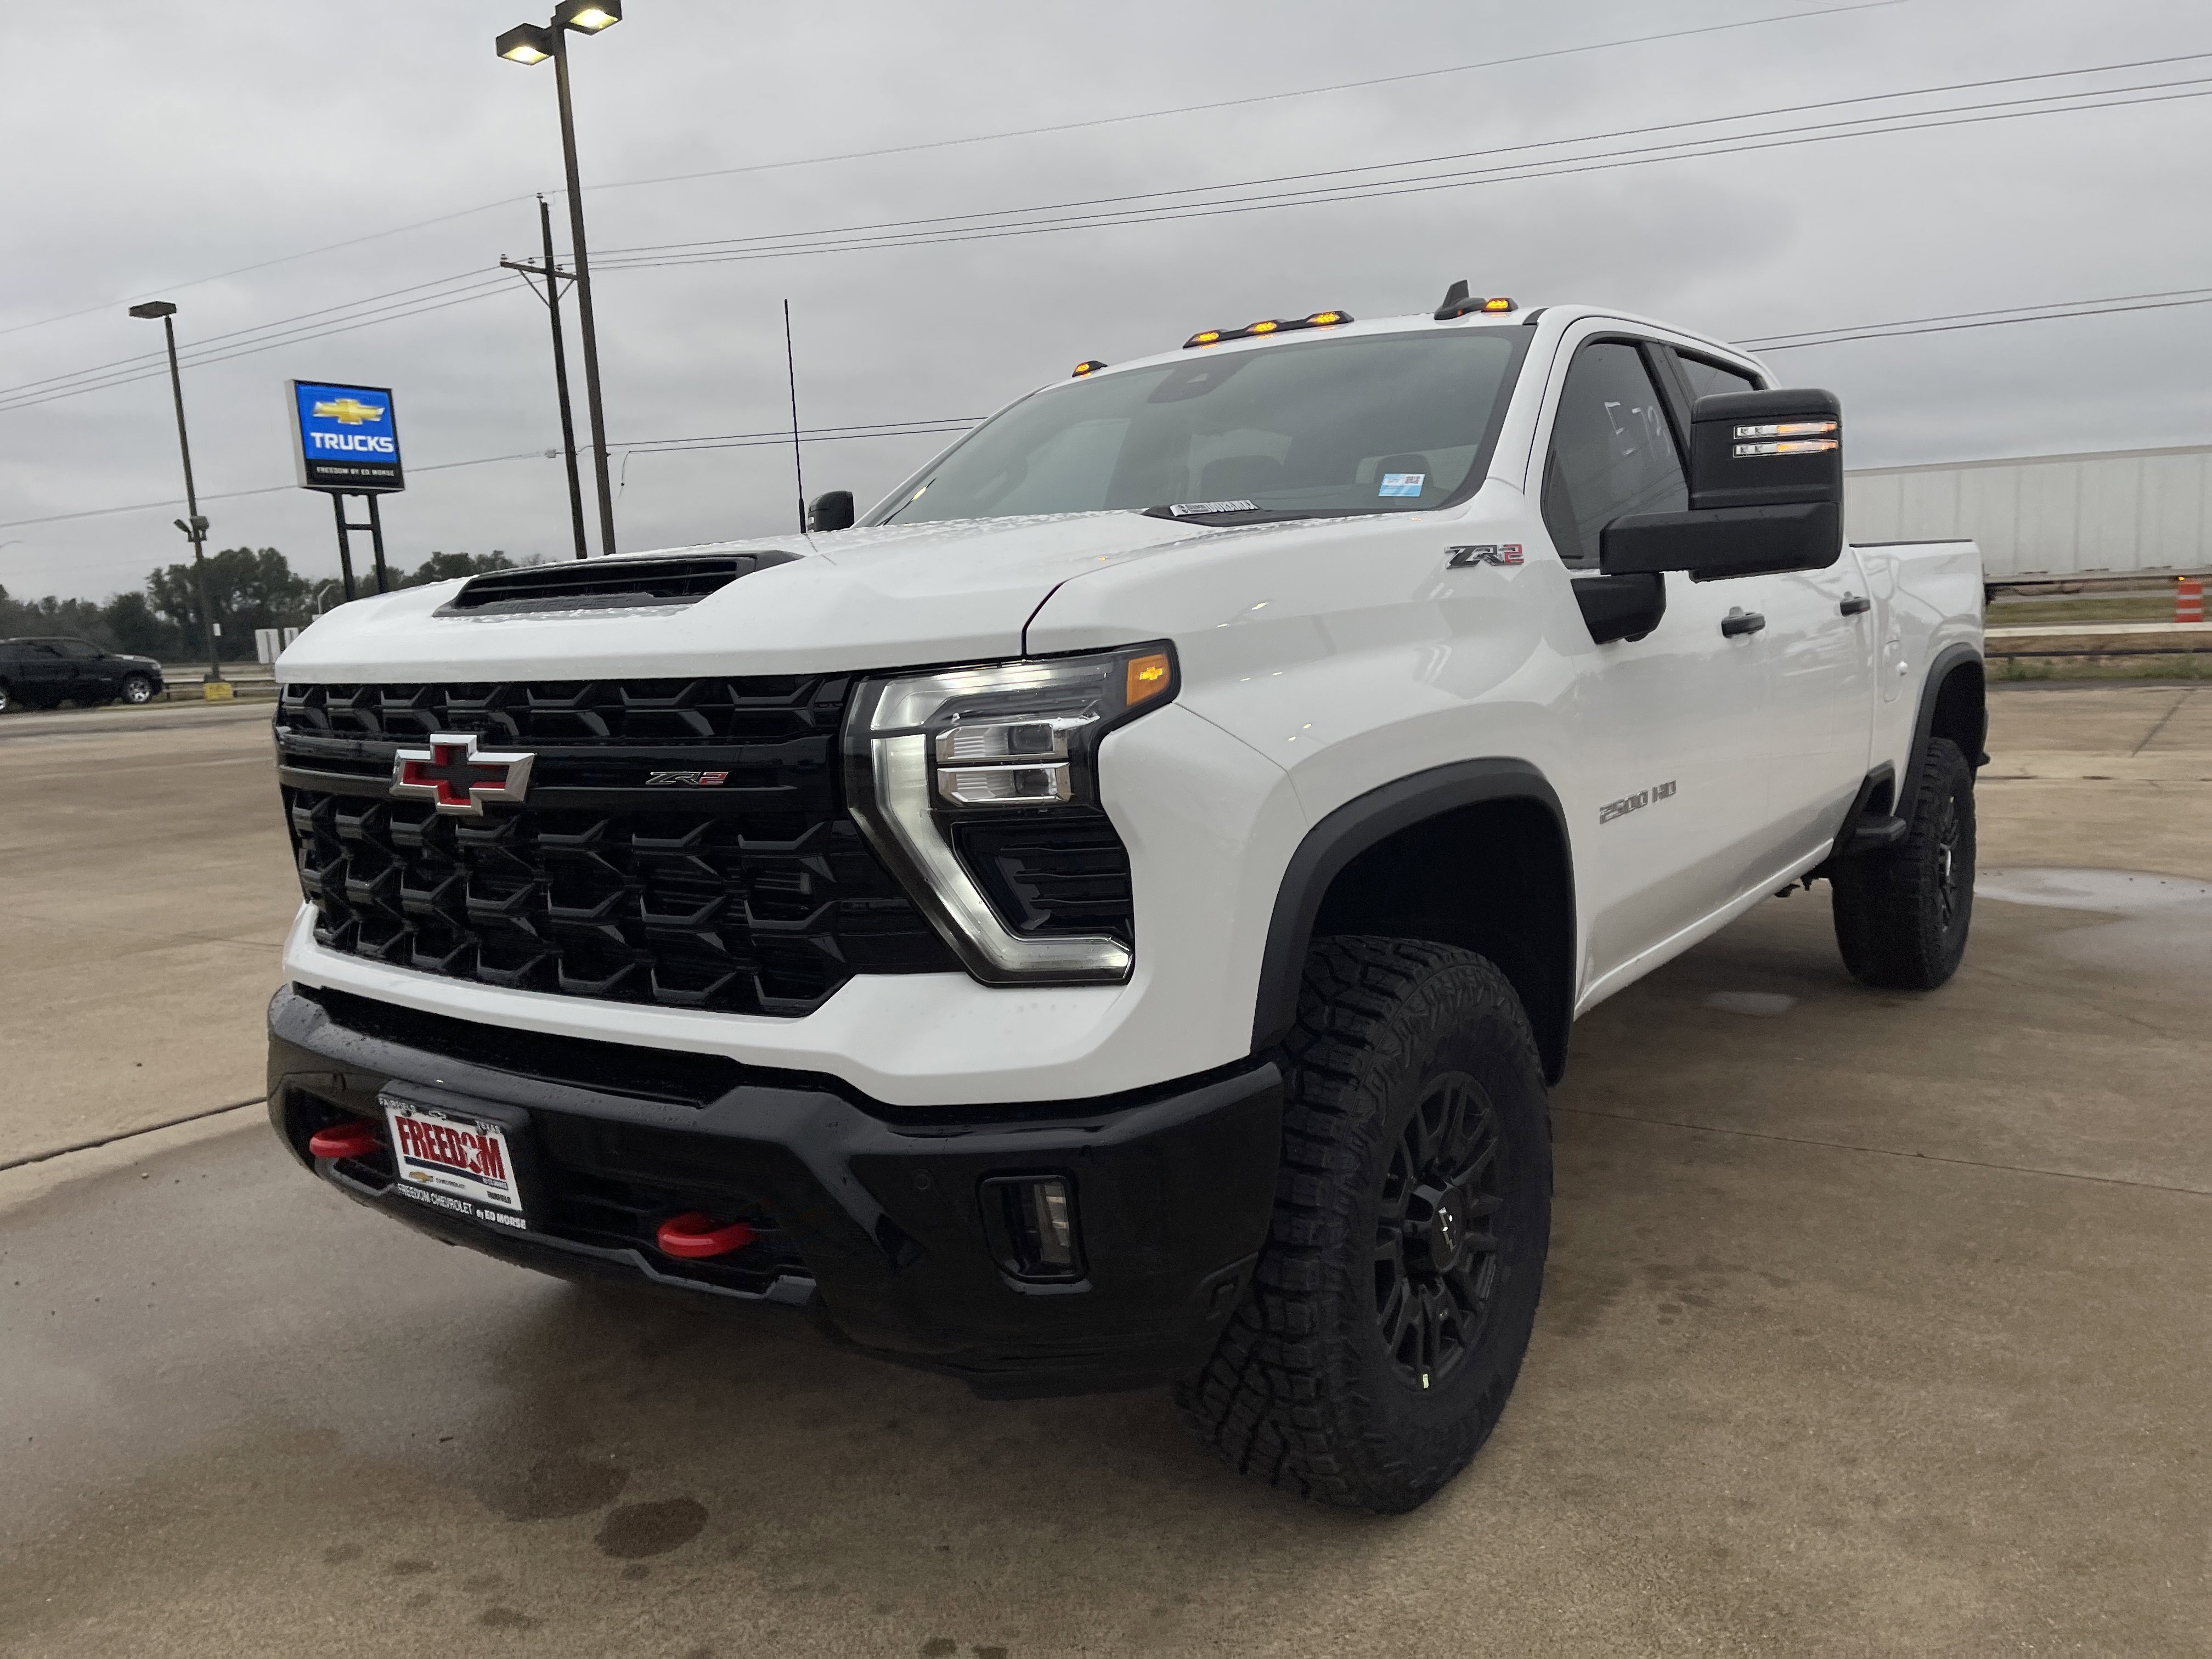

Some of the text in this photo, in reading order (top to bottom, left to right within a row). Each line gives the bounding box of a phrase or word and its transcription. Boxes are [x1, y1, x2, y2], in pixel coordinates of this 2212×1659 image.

[310, 432, 394, 453] TRUCKS
[1206, 500, 1259, 512] DURAMAX
[1444, 544, 1524, 569] ZR2
[646, 771, 729, 785] ZR2
[1599, 780, 1677, 824] 2500 HD
[394, 1115, 506, 1180] FREEDOM
[398, 1183, 431, 1203] FREEDOM
[431, 1193, 472, 1215] CHEVROLET
[484, 1210, 495, 1222] ED
[496, 1213, 526, 1229] MORSE
